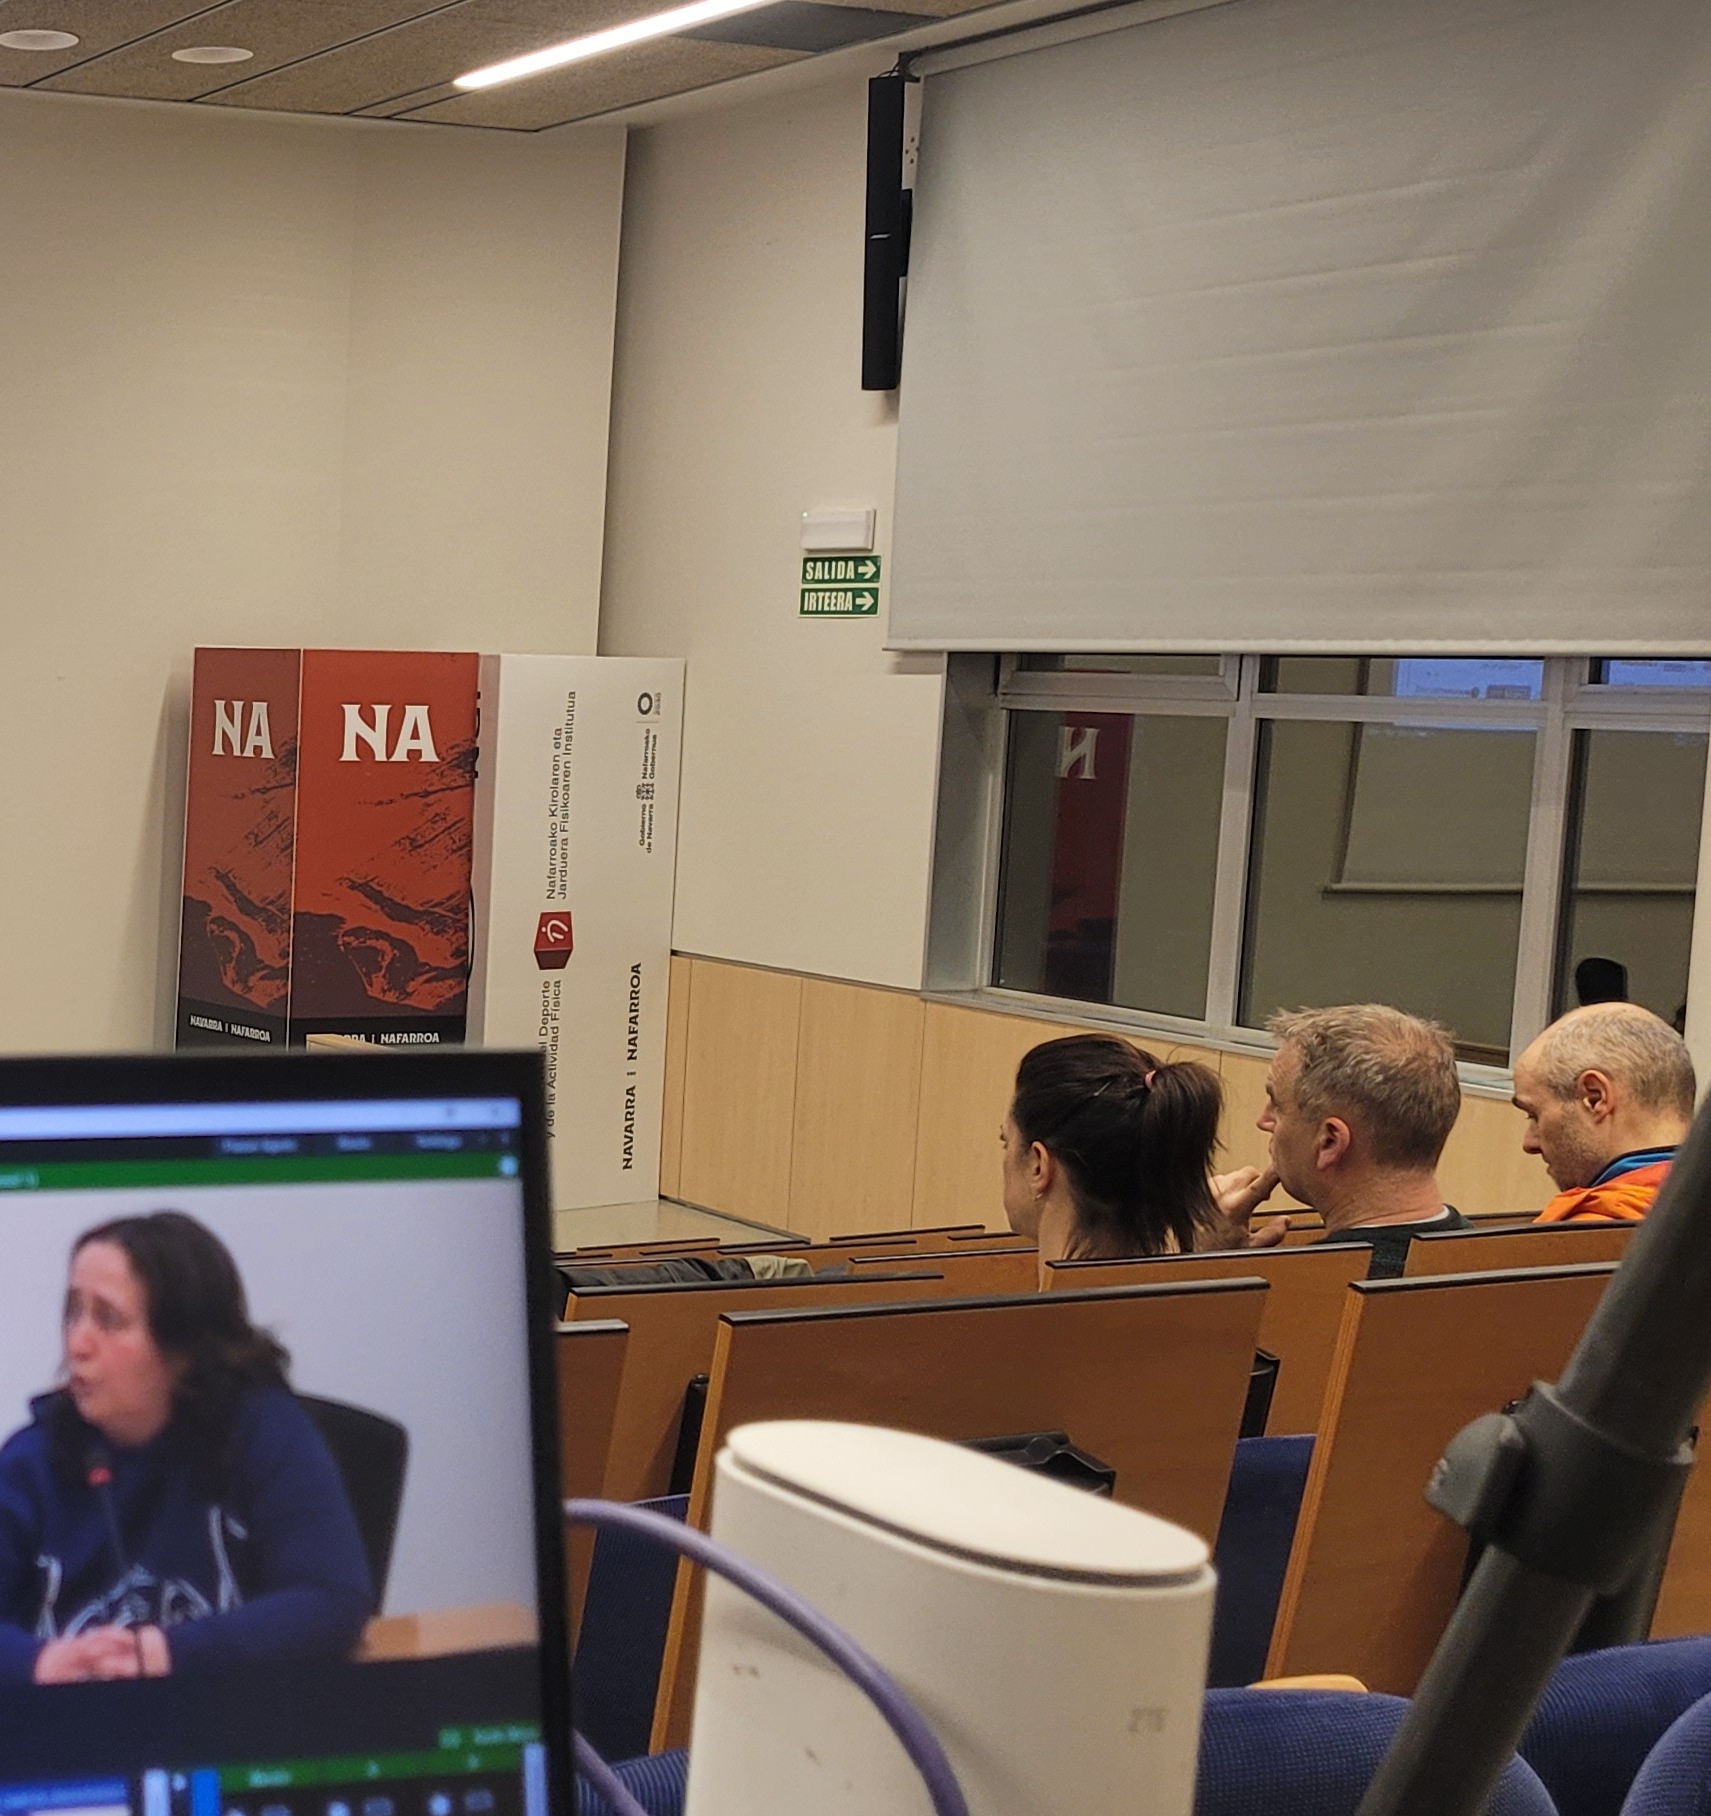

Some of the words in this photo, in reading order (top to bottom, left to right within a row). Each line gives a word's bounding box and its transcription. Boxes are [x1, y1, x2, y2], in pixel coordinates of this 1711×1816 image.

[805, 560, 855, 581] SALIDA
[803, 590, 854, 612] IRTEERA
[210, 698, 276, 761] NA
[338, 702, 442, 764] NA
[562, 690, 576, 756] Institutua
[641, 728, 651, 780] Nafarroako
[648, 734, 658, 780] Gobernua
[639, 803, 647, 847] Gobierno
[646, 803, 654, 840] Navarra
[546, 821, 558, 900] Nafarroako
[551, 979, 562, 1022] Física
[627, 962, 642, 1062] NAFARROA
[190, 1014, 223, 1033] NAVARRA
[231, 1024, 272, 1043] NAFARROA
[380, 1032, 440, 1045] NAFARROA
[549, 1026, 560, 1090] Actividad
[622, 1085, 636, 1171] NAVARRA
